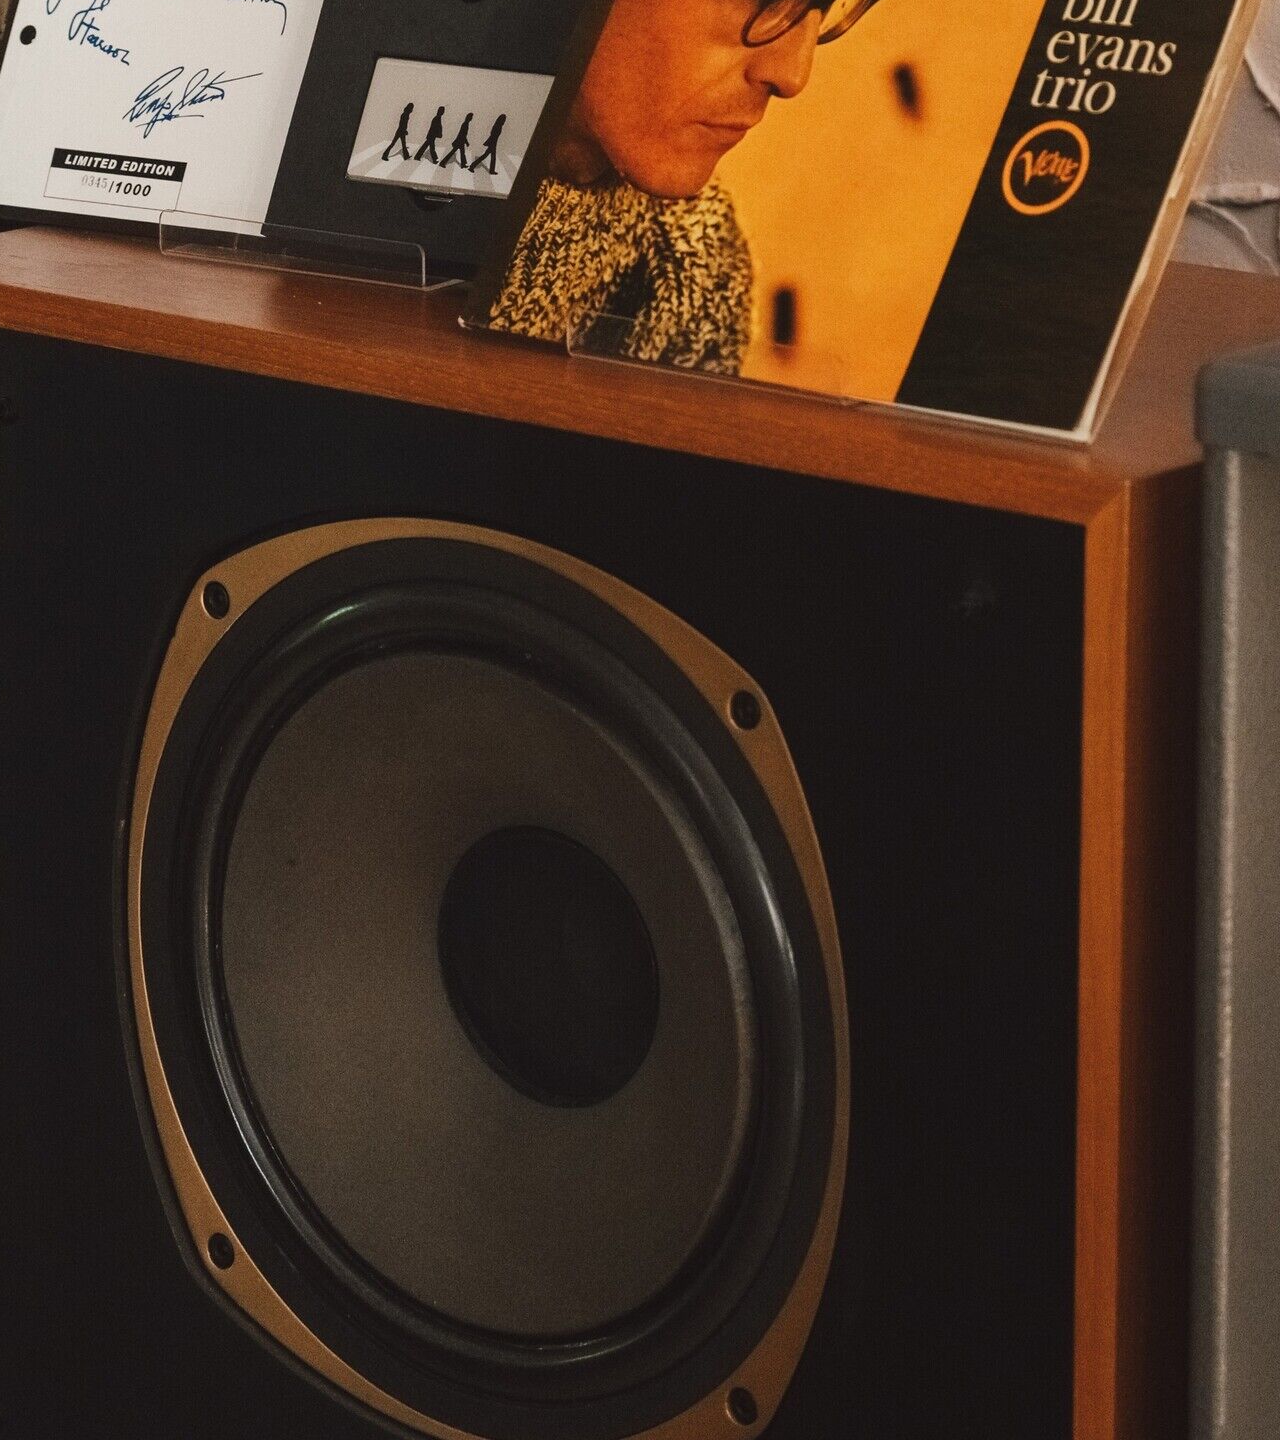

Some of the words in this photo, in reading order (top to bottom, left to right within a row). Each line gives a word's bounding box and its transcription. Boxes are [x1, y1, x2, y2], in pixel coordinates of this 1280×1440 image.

[1046, 29, 1177, 76] evans
[1030, 68, 1116, 114] trio
[64, 154, 118, 170] LIMITED
[120, 160, 175, 176] EDITION
